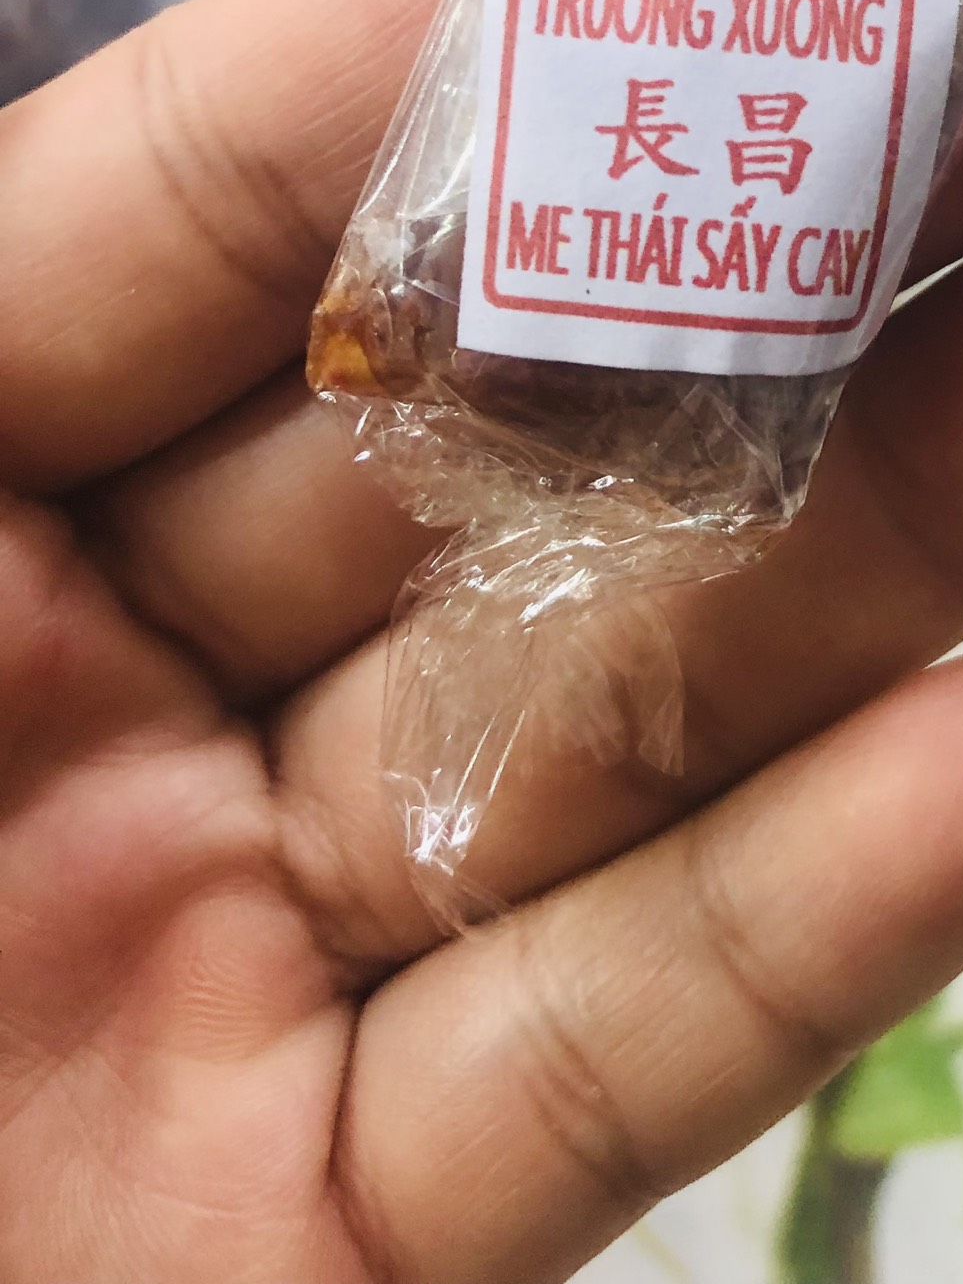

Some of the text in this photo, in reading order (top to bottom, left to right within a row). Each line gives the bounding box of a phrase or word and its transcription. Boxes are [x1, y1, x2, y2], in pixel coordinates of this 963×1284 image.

[595, 77, 814, 196] 長昌
[505, 192, 871, 297] ME THÁI SẤY CAY
